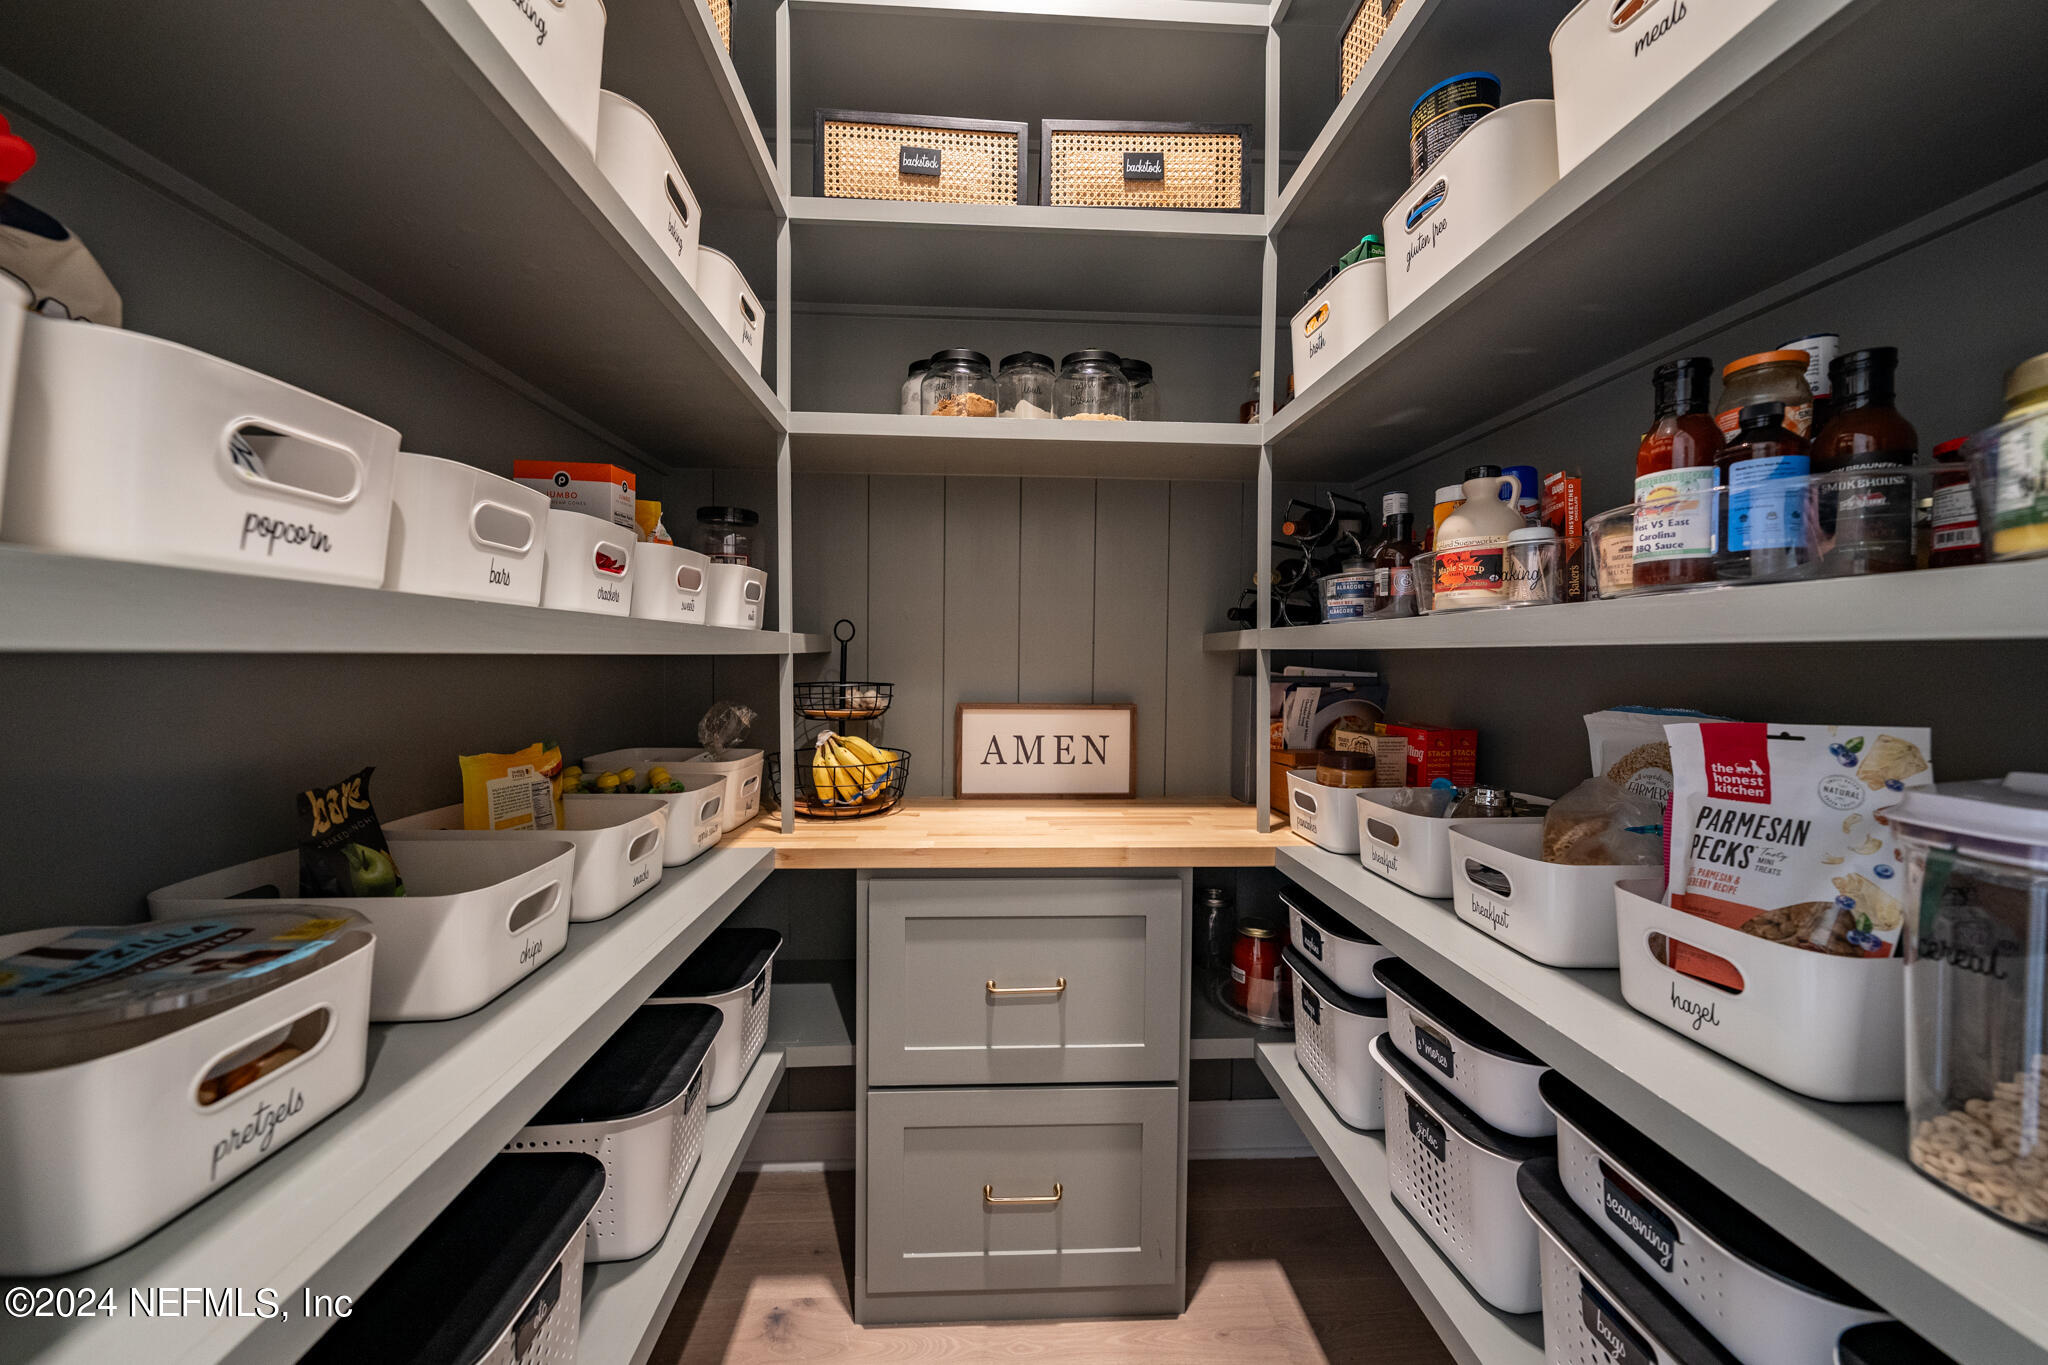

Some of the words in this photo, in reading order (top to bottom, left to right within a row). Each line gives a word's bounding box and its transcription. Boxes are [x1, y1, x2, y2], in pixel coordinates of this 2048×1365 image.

[1634, 0, 1687, 57] meals
[902, 152, 939, 169] backstock
[1126, 158, 1162, 173] backstock
[1406, 232, 1431, 272] gluten
[1432, 218, 1447, 248] free
[1309, 331, 1326, 358] broth
[239, 512, 333, 556] popcorn
[1639, 531, 1676, 541] Carolina
[1651, 520, 1664, 528] VS
[1668, 518, 1690, 527] East
[1655, 541, 1684, 551] Sauce
[489, 557, 511, 586] bars
[1438, 564, 1457, 576] Maple
[1458, 562, 1485, 574] Syrup
[1497, 560, 1542, 590] aking
[979, 734, 1111, 766] AMEN
[1452, 748, 1476, 757] STACK
[1711, 763, 1734, 774] the
[1714, 773, 1764, 787] honest
[1714, 783, 1764, 798] kitchen
[1823, 786, 1859, 800] NATURAL
[305, 778, 370, 837] bare
[1695, 805, 1812, 847] PARMESAN
[1371, 844, 1398, 874] breakfast
[1690, 834, 1755, 869] PECKS
[1757, 856, 1775, 866] MINI
[1697, 867, 1734, 883] PARMESAN
[1754, 864, 1783, 876] TREATS
[1712, 882, 1738, 895] RECIPE
[1472, 893, 1510, 930] breakfast
[520, 938, 543, 967] chips
[1919, 939, 2008, 980] cereal
[1671, 981, 1720, 1030] hazel
[1417, 1037, 1448, 1068] s'mores
[210, 1087, 305, 1181] pretzels
[1415, 1121, 1439, 1149] ziploc
[1606, 1192, 1673, 1268] seasoning
[1596, 1308, 1626, 1359] bags
